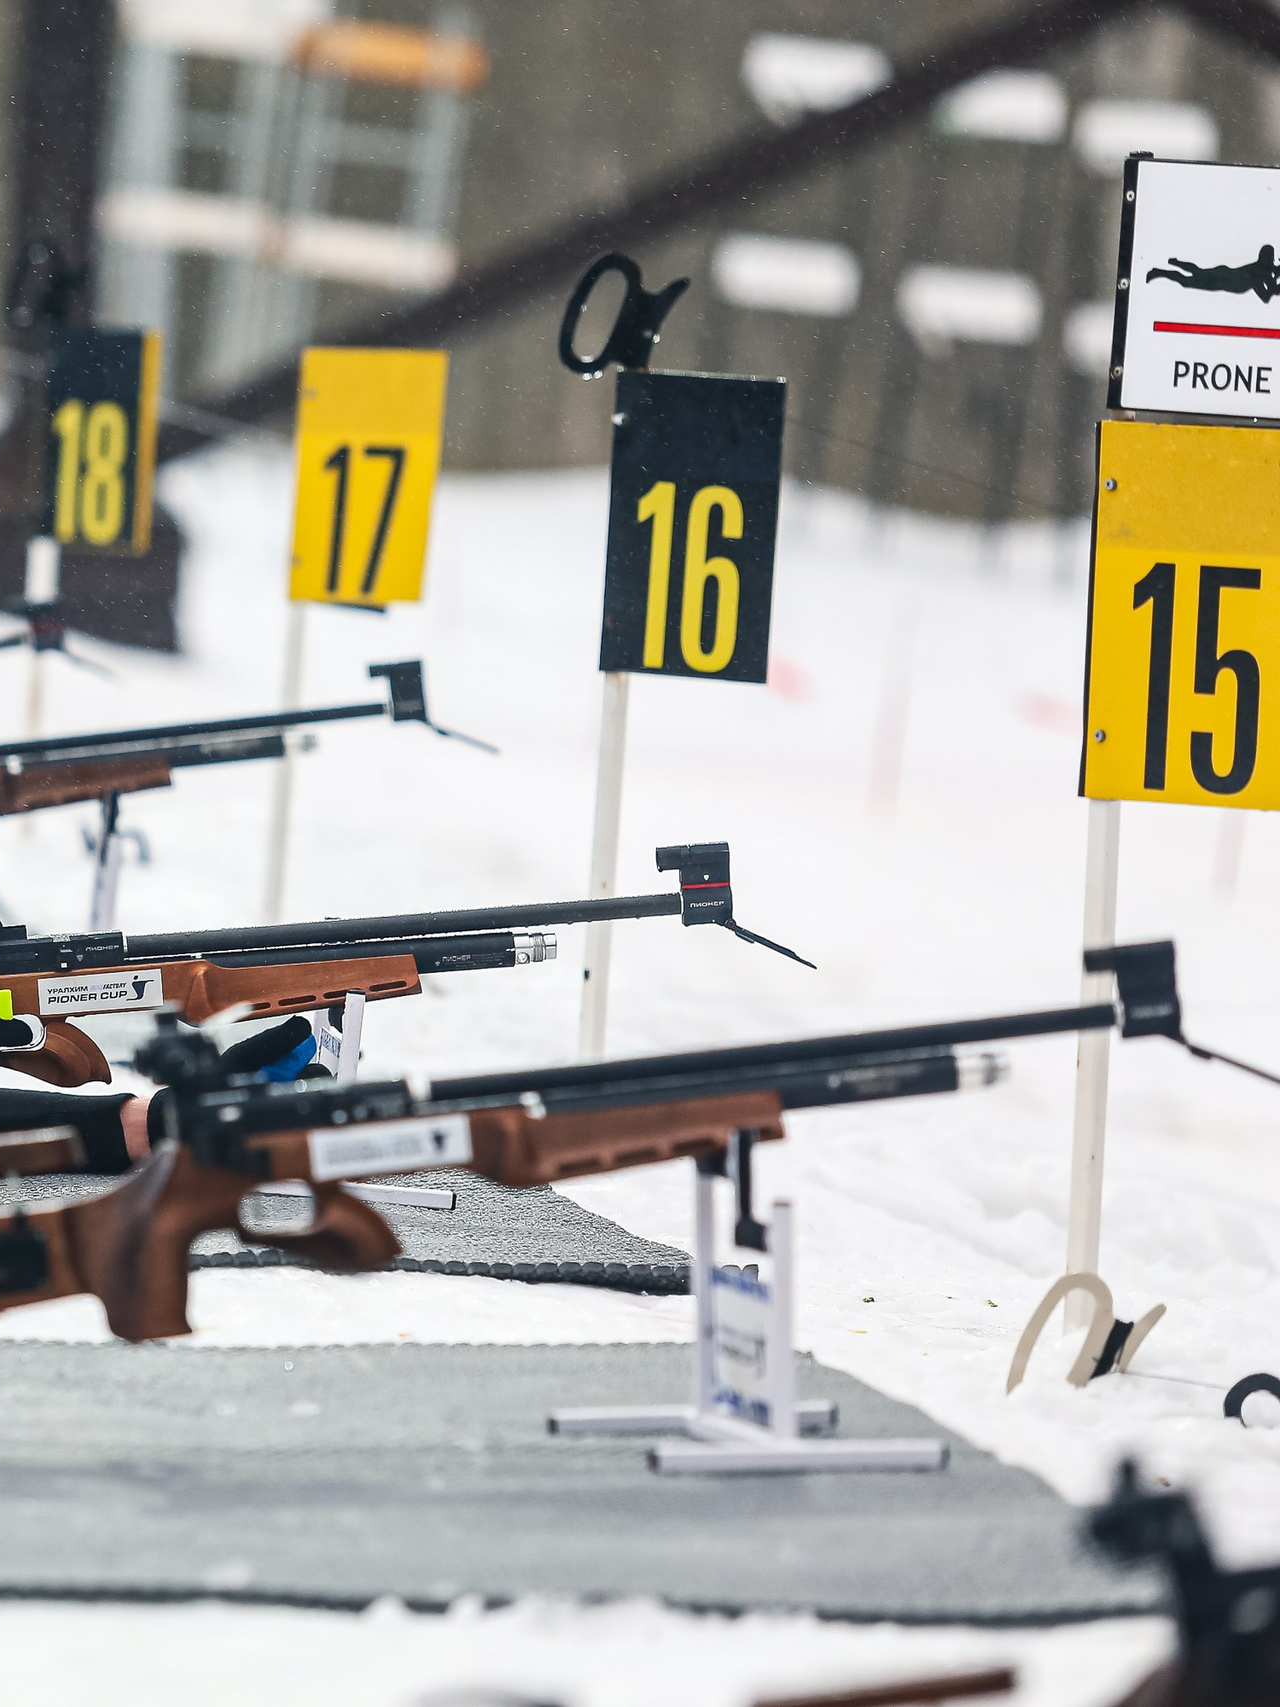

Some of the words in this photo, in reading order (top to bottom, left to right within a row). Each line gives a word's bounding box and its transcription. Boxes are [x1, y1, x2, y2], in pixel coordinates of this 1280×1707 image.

[1173, 360, 1273, 394] PRONE
[53, 400, 128, 545] 18
[324, 445, 406, 595] 17
[636, 480, 745, 673] 16
[1132, 561, 1262, 796] 15
[690, 900, 725, 908] ПИОНЕР
[47, 985, 89, 995] УРАЛХИМ
[48, 992, 97, 1004] PIONER
[100, 990, 128, 1000] CUP
